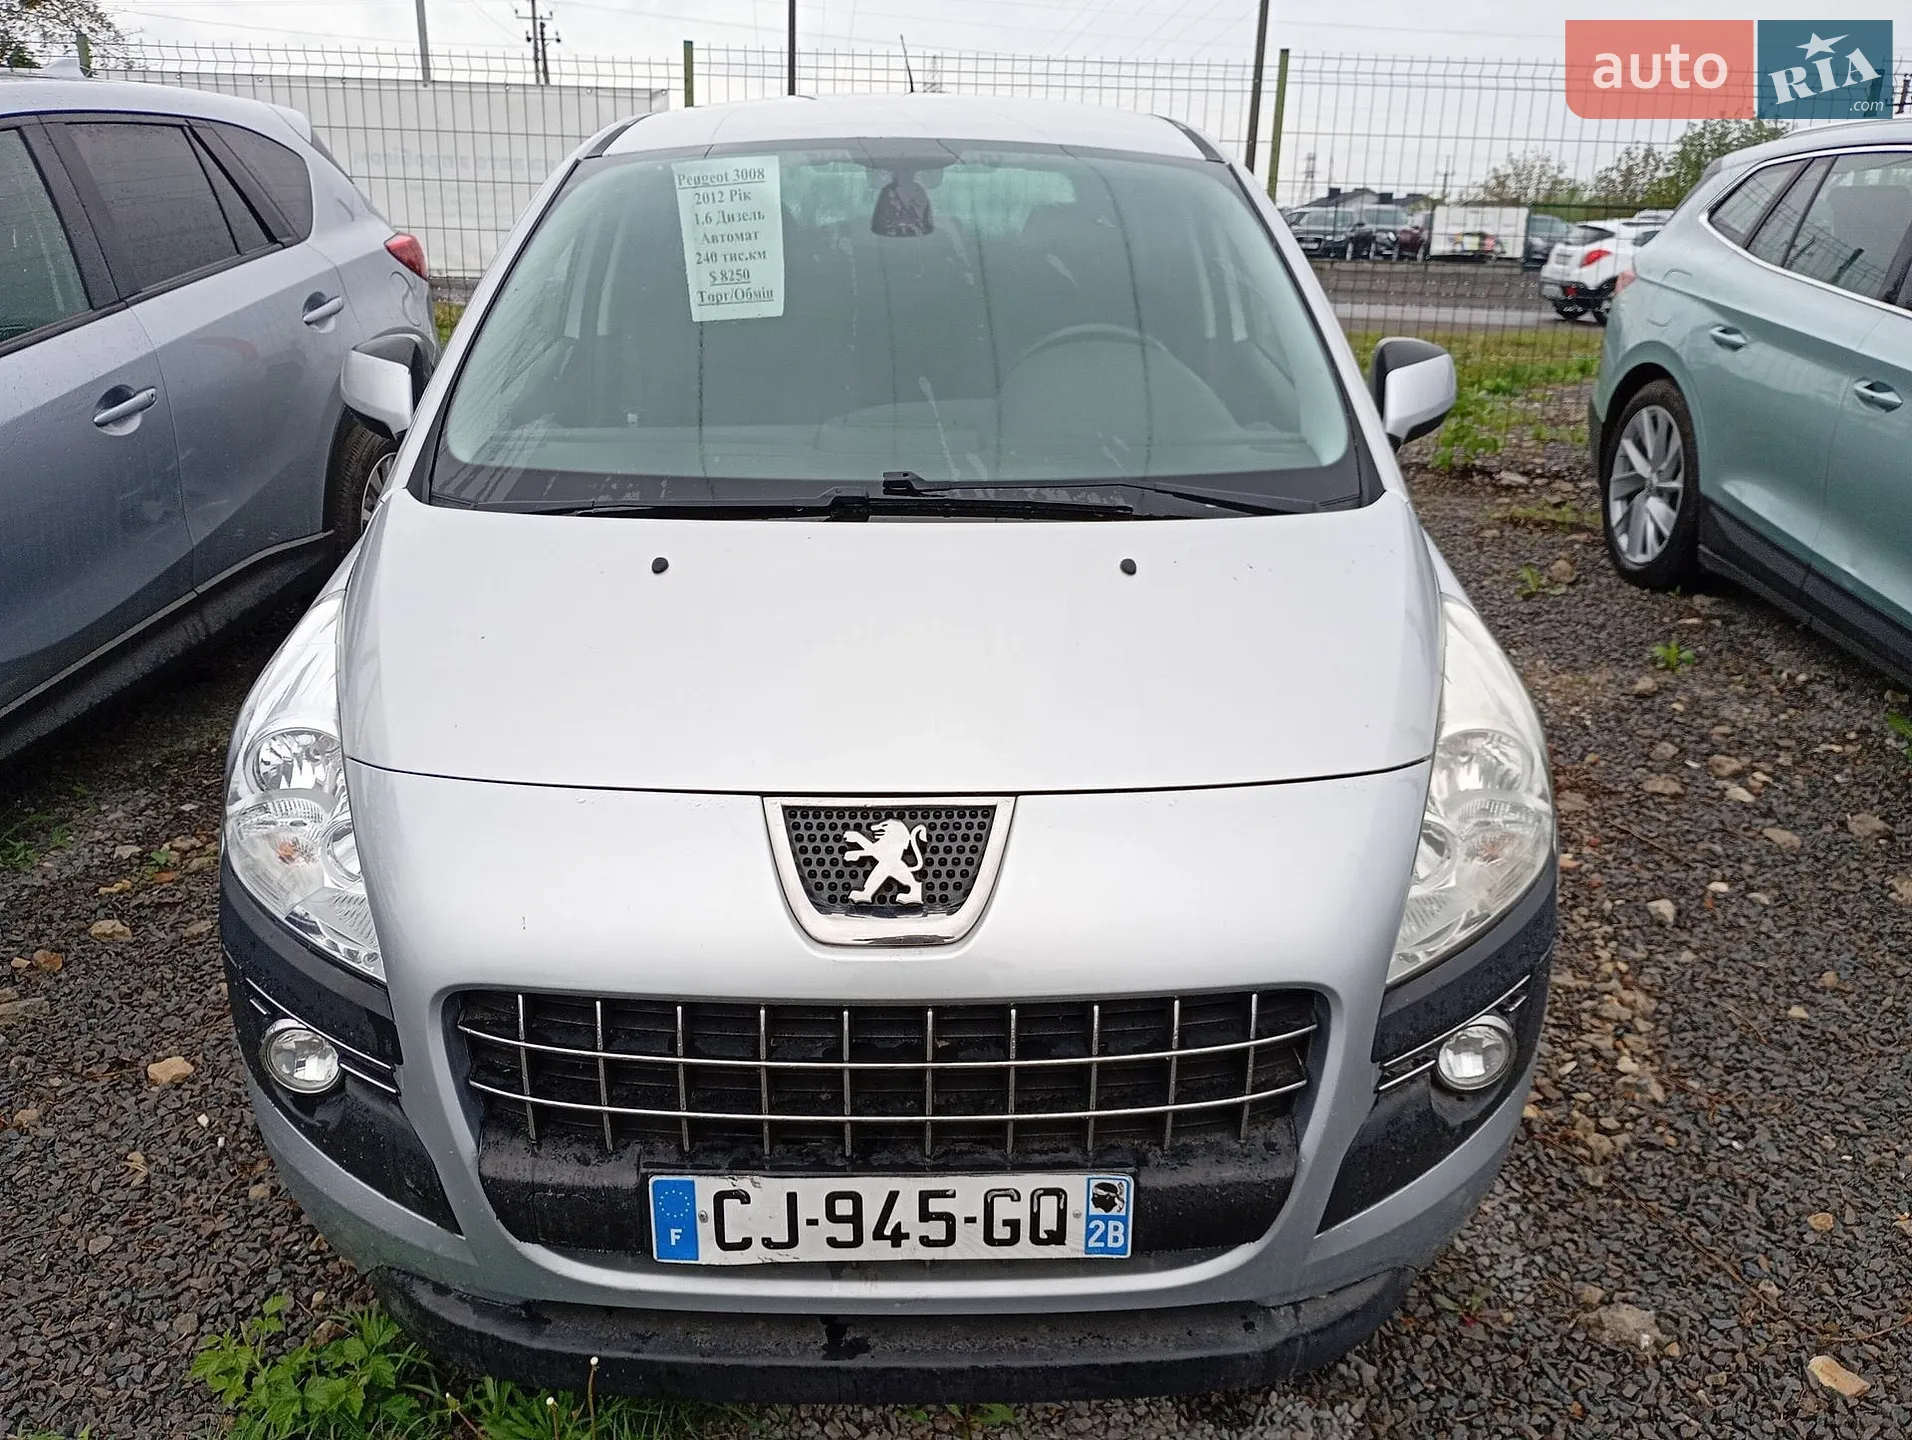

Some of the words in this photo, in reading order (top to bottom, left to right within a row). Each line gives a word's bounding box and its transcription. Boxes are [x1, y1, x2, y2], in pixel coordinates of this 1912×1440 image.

[678, 171, 729, 188] Peugeot
[733, 168, 765, 182] 3008
[694, 191, 725, 205] 2012
[729, 188, 752, 203] Рік
[694, 212, 713, 226] 1.6
[716, 210, 765, 226] Дизель
[701, 230, 760, 245] Автомат
[695, 251, 718, 265] 240
[722, 249, 767, 263] тис.км
[720, 268, 750, 282] 8250
[697, 287, 774, 305] Торг/Обмін
[712, 1188, 1068, 1252] CJ-945-GQ
[670, 1228, 682, 1246] F
[1088, 1219, 1126, 1249] 2B
